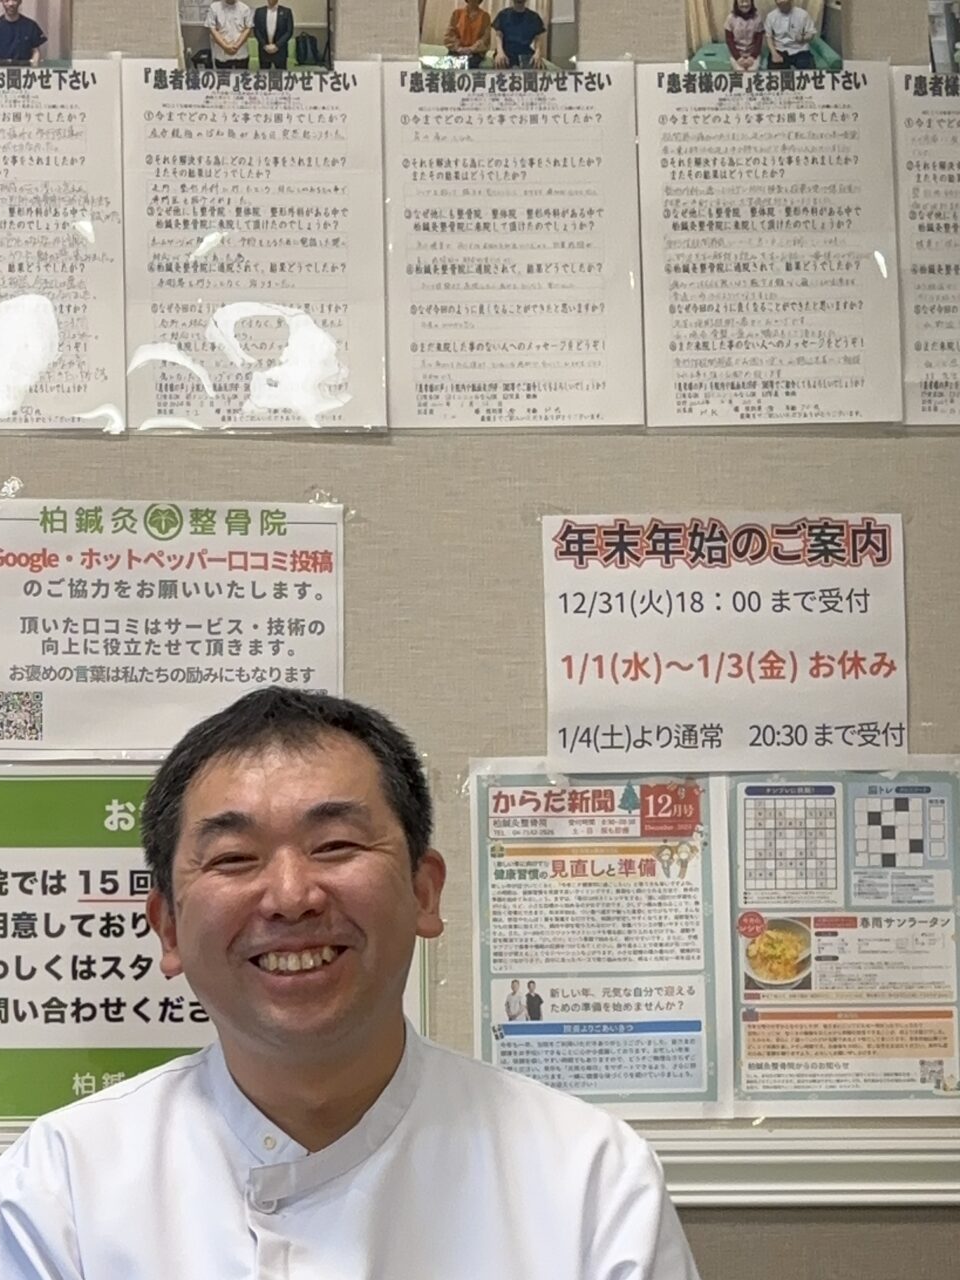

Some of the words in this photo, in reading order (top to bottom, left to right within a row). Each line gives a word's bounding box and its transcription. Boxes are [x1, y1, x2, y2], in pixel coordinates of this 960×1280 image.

[143, 68, 357, 92] 『患者様の声』をお聞かせ下さい
[400, 71, 612, 93] 『患者様の声』をお聞かせ下さい
[657, 71, 868, 94] 『患者様の声』をお聞かせ下さい
[39, 505, 139, 536] 柏鍼灸
[189, 507, 288, 537] 整骨院
[554, 517, 893, 568] 年末年始のご案内
[23, 578, 324, 601] のご協力をお願いいたします。
[771, 588, 870, 615] まで受付
[20, 616, 326, 637] 頂いた口コミはサービス・技術の
[41, 638, 297, 658] 向上に役立たせて頂きます。
[9, 664, 316, 685] お褒めの言葉は私たちの励みにもなります
[809, 651, 897, 680] お休み
[558, 722, 724, 753] 1/4(土)より通常
[749, 724, 808, 748] 20:30
[813, 721, 906, 748] まで受付
[492, 789, 615, 814] からだ新聞
[644, 793, 694, 818] 12月号
[104, 799, 142, 831] お
[550, 985, 695, 998] 新しい年、元気な自分で迎える
